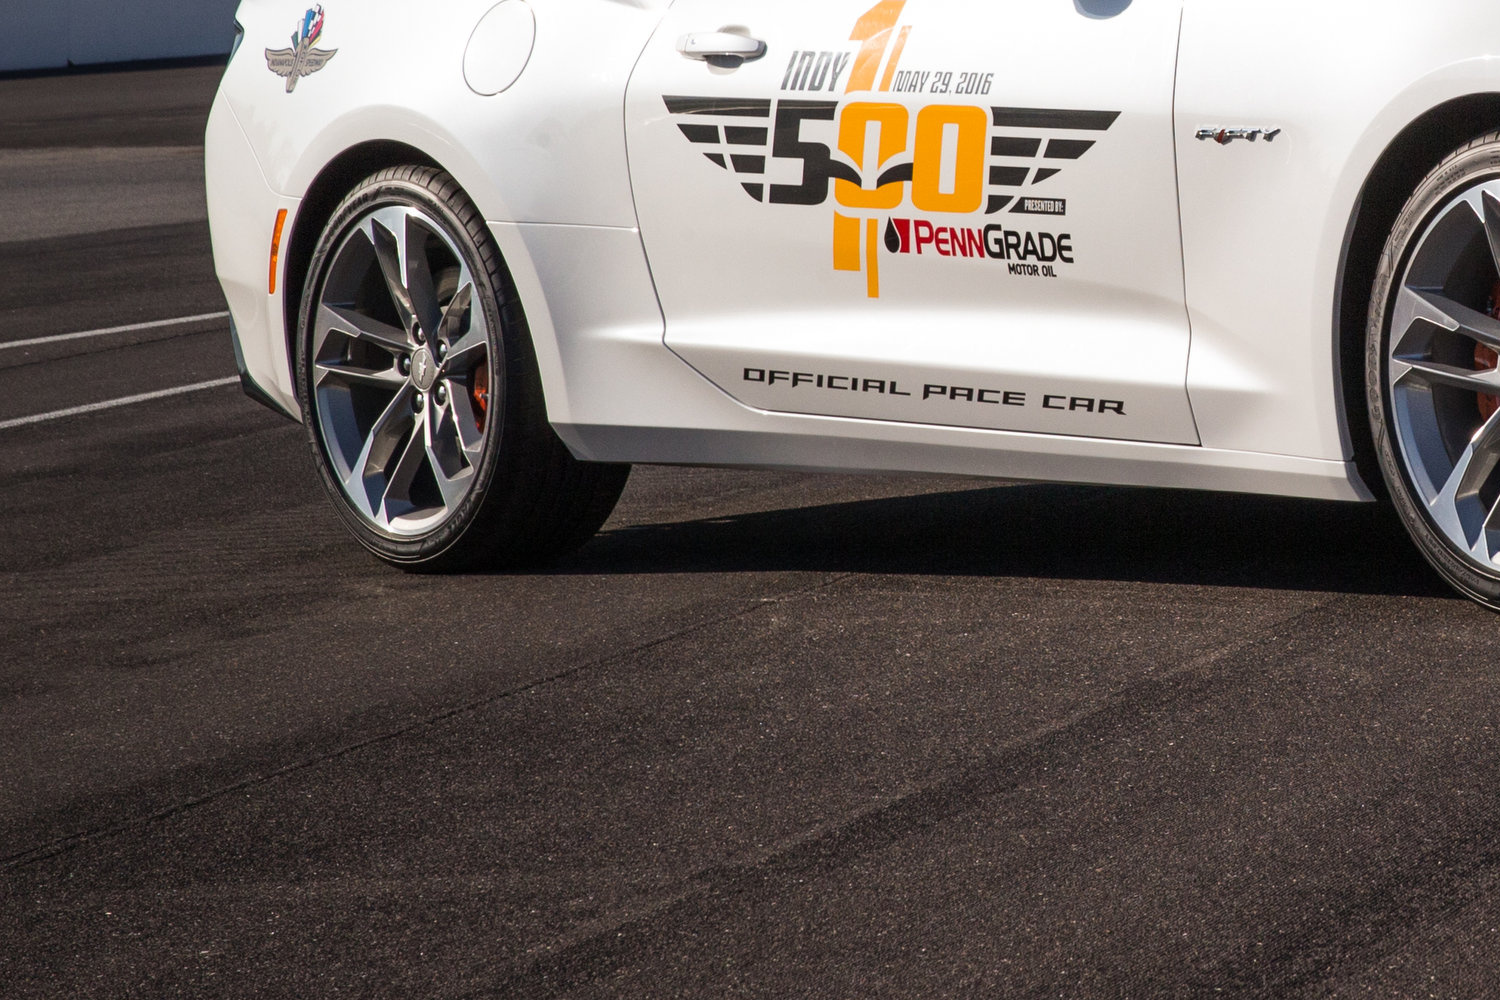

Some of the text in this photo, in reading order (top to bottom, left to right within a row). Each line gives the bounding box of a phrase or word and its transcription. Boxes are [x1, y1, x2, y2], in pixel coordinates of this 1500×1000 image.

[780, 51, 850, 92] INDY
[892, 70, 930, 94] MAY
[955, 72, 995, 95] 2016
[769, 99, 988, 214] 500
[1024, 199, 1054, 213] PRESENTED
[1008, 263, 1057, 278] MOTOR OIL
[743, 367, 1127, 415] OFFICIAL PACE CAR
